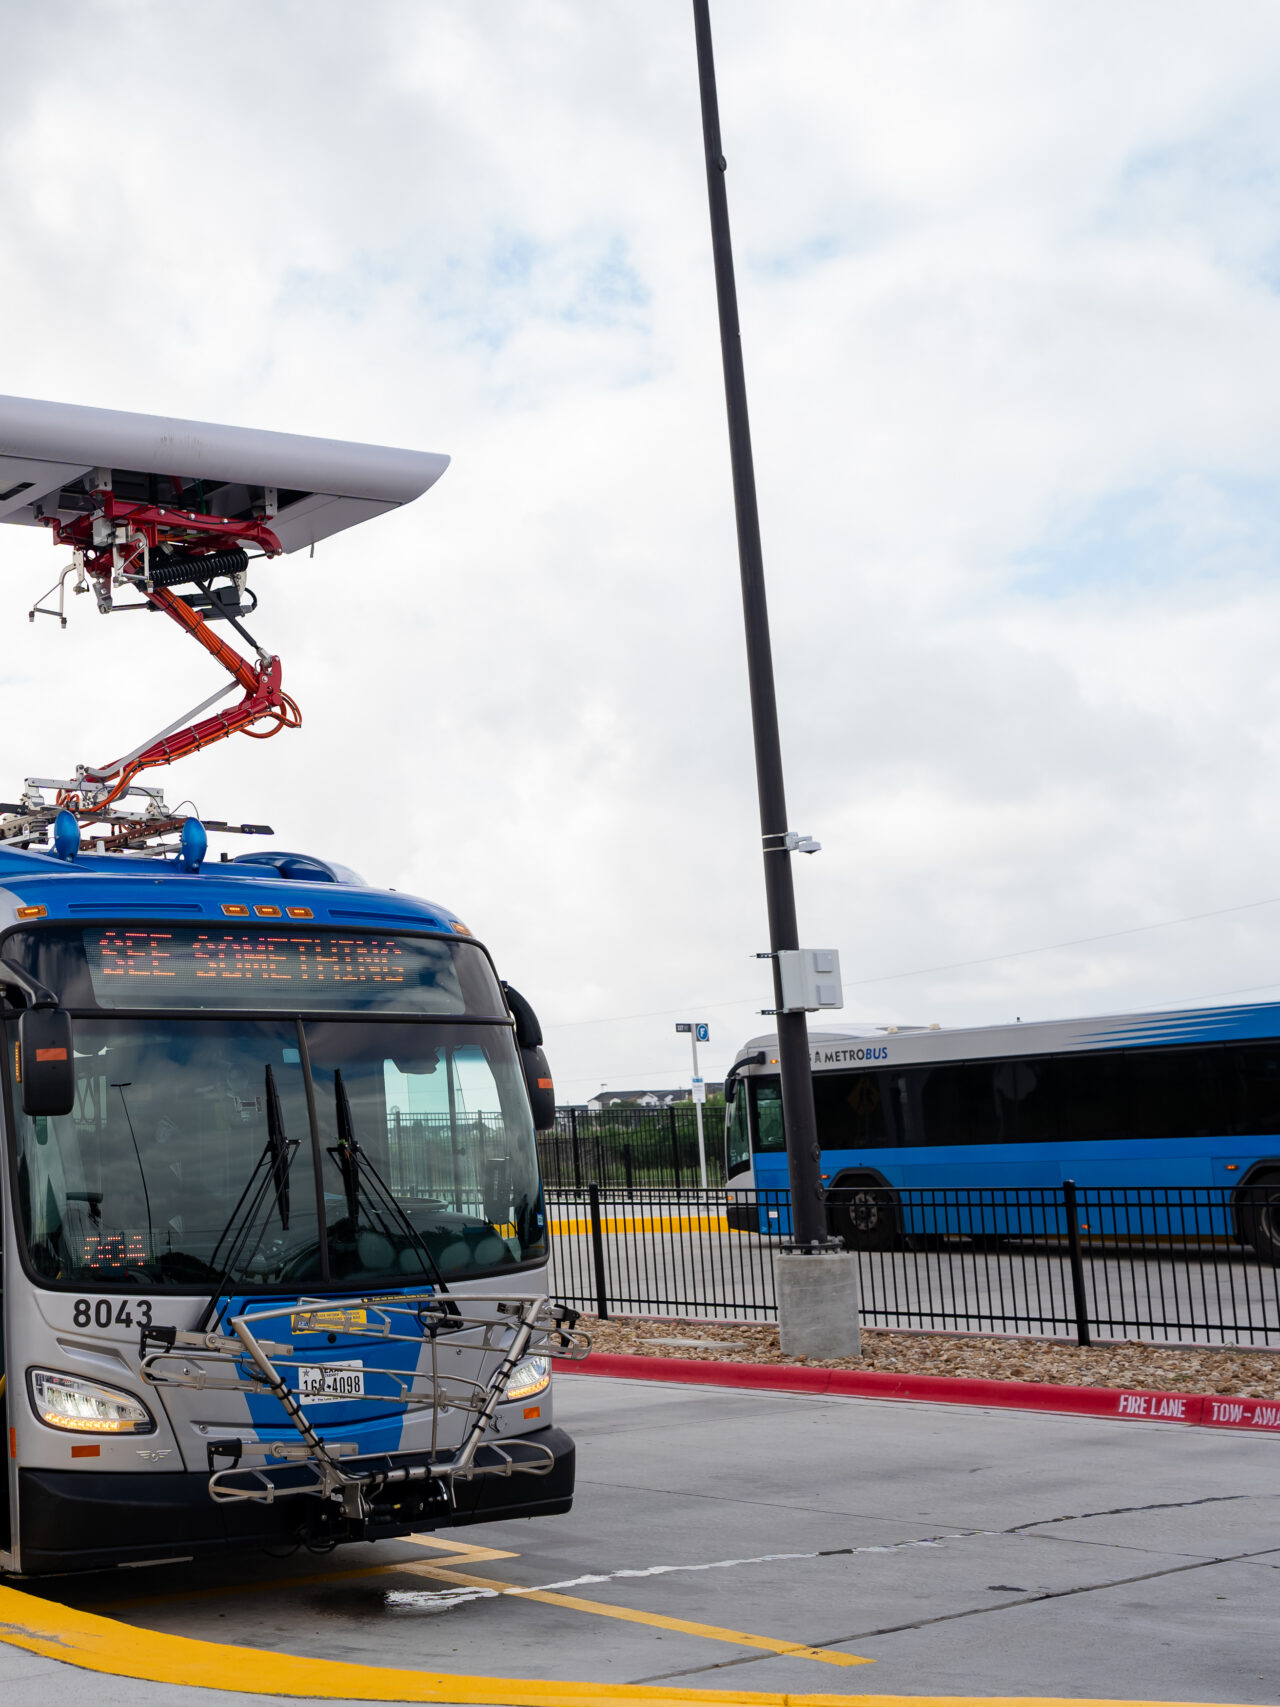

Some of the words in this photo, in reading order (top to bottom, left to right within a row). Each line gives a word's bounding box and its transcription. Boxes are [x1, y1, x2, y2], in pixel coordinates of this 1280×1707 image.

[99, 932, 176, 975] SEE
[192, 935, 404, 981] SOMETHING
[824, 1047, 888, 1063] METROBUS
[73, 1298, 153, 1328] 8043
[1118, 1394, 1149, 1415] FIRE
[1150, 1397, 1187, 1418] LANE
